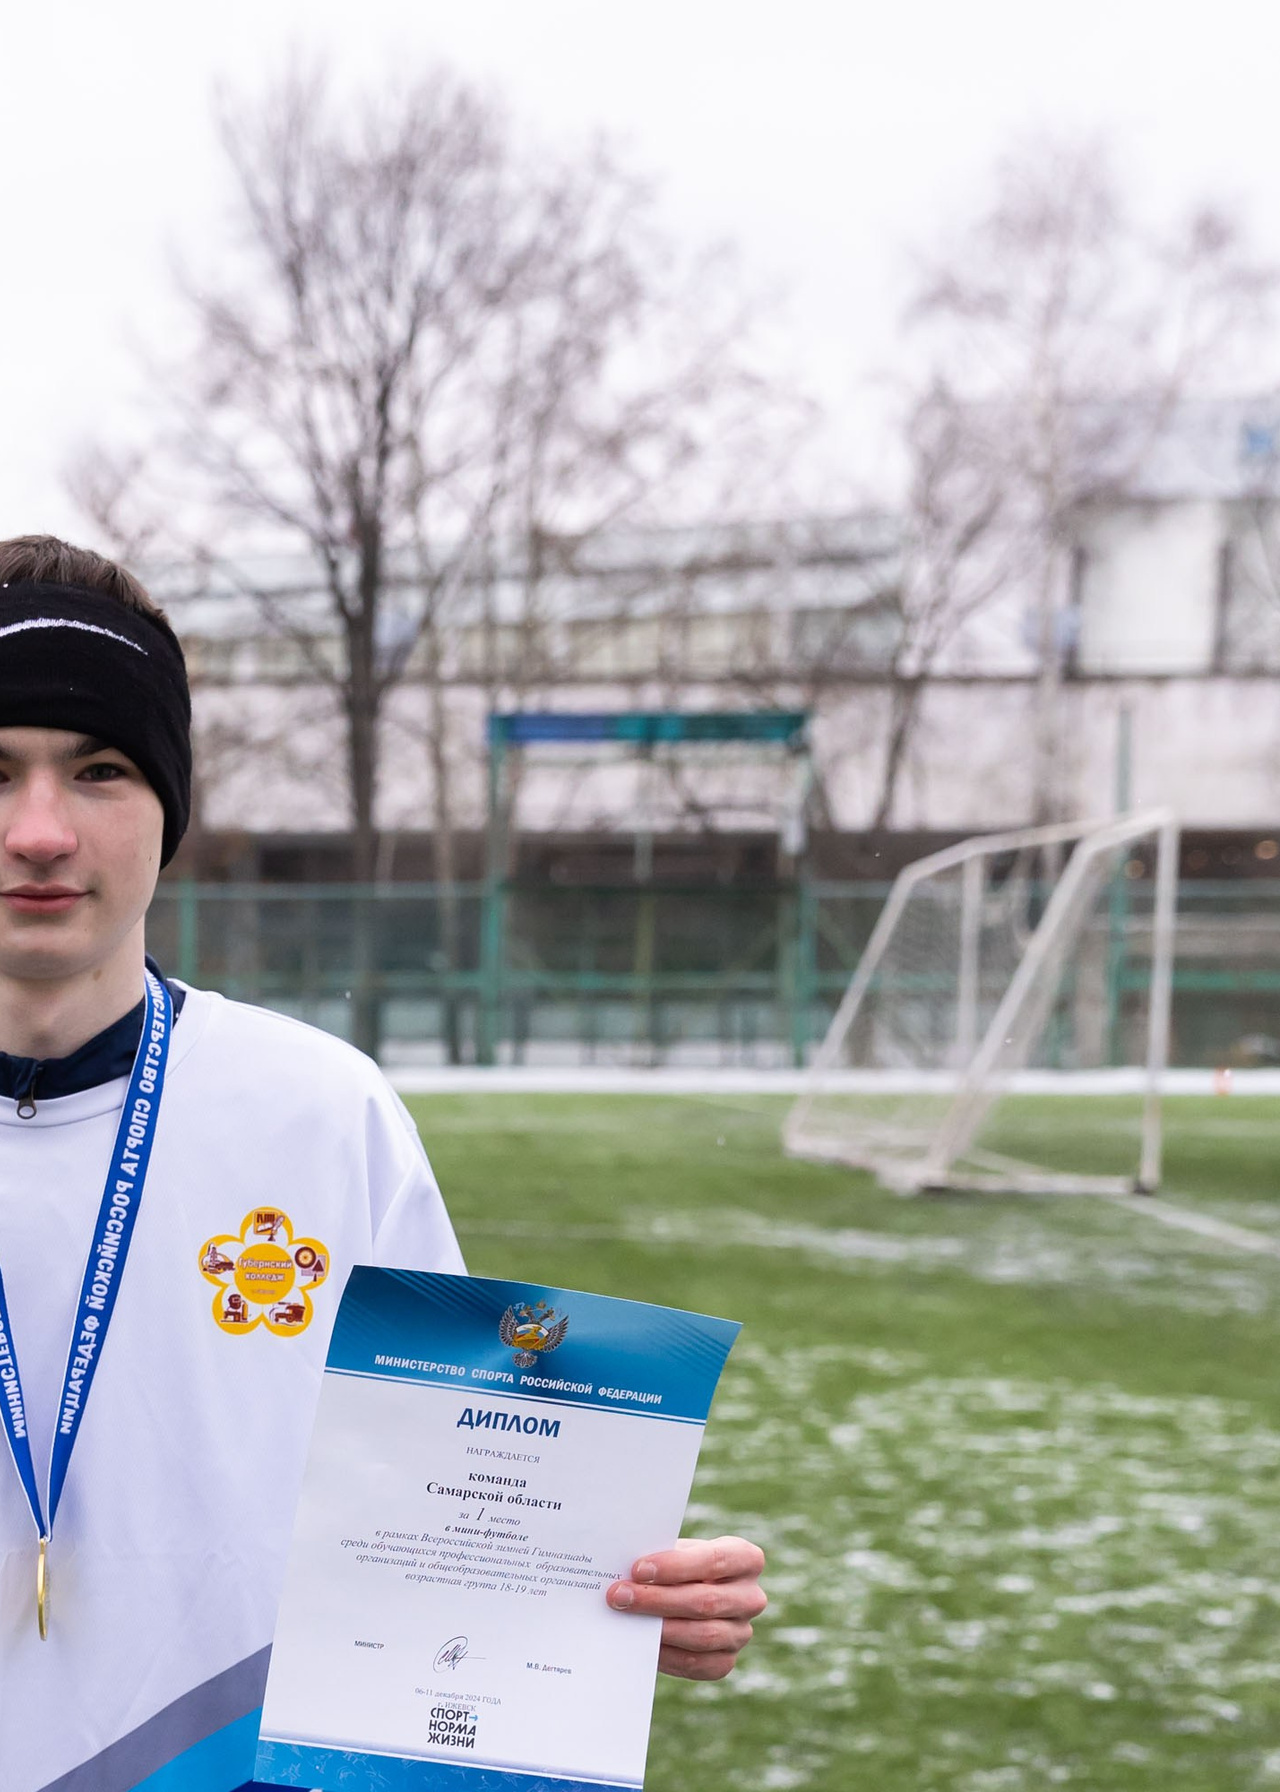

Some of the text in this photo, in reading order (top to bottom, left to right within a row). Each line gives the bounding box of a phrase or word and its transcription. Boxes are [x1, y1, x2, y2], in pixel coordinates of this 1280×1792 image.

[238, 1257, 292, 1270] Губернский
[374, 1354, 662, 1405] МИНИСТЕРСТВО СПОРТА РОССИЙСКОЙ ФЕДЕРАЦИИ
[456, 1407, 561, 1438] ДИПЛОМ
[466, 1446, 540, 1464] НАГРАЖДАЕТСЯ
[468, 1472, 527, 1489] команда
[426, 1481, 562, 1510] Самарской области
[458, 1511, 470, 1520] за
[488, 1515, 521, 1526] место
[452, 1526, 529, 1542] мини-футболе
[382, 1531, 419, 1542] рамках
[420, 1533, 493, 1550] Всероссийской
[495, 1544, 530, 1556] зимней
[531, 1547, 593, 1563] Гимназиады
[340, 1538, 622, 1580] среди обучающихся профессиональных образовательных
[356, 1553, 417, 1568] организаций
[427, 1562, 538, 1583] общеобразовательных
[540, 1575, 601, 1591] организаций
[405, 1572, 547, 1597] возрастная группа 18-19 лет
[430, 1707, 470, 1722] СПОРТ
[428, 1719, 476, 1736] НОРМА
[427, 1732, 475, 1749] ЖИЗНИ
